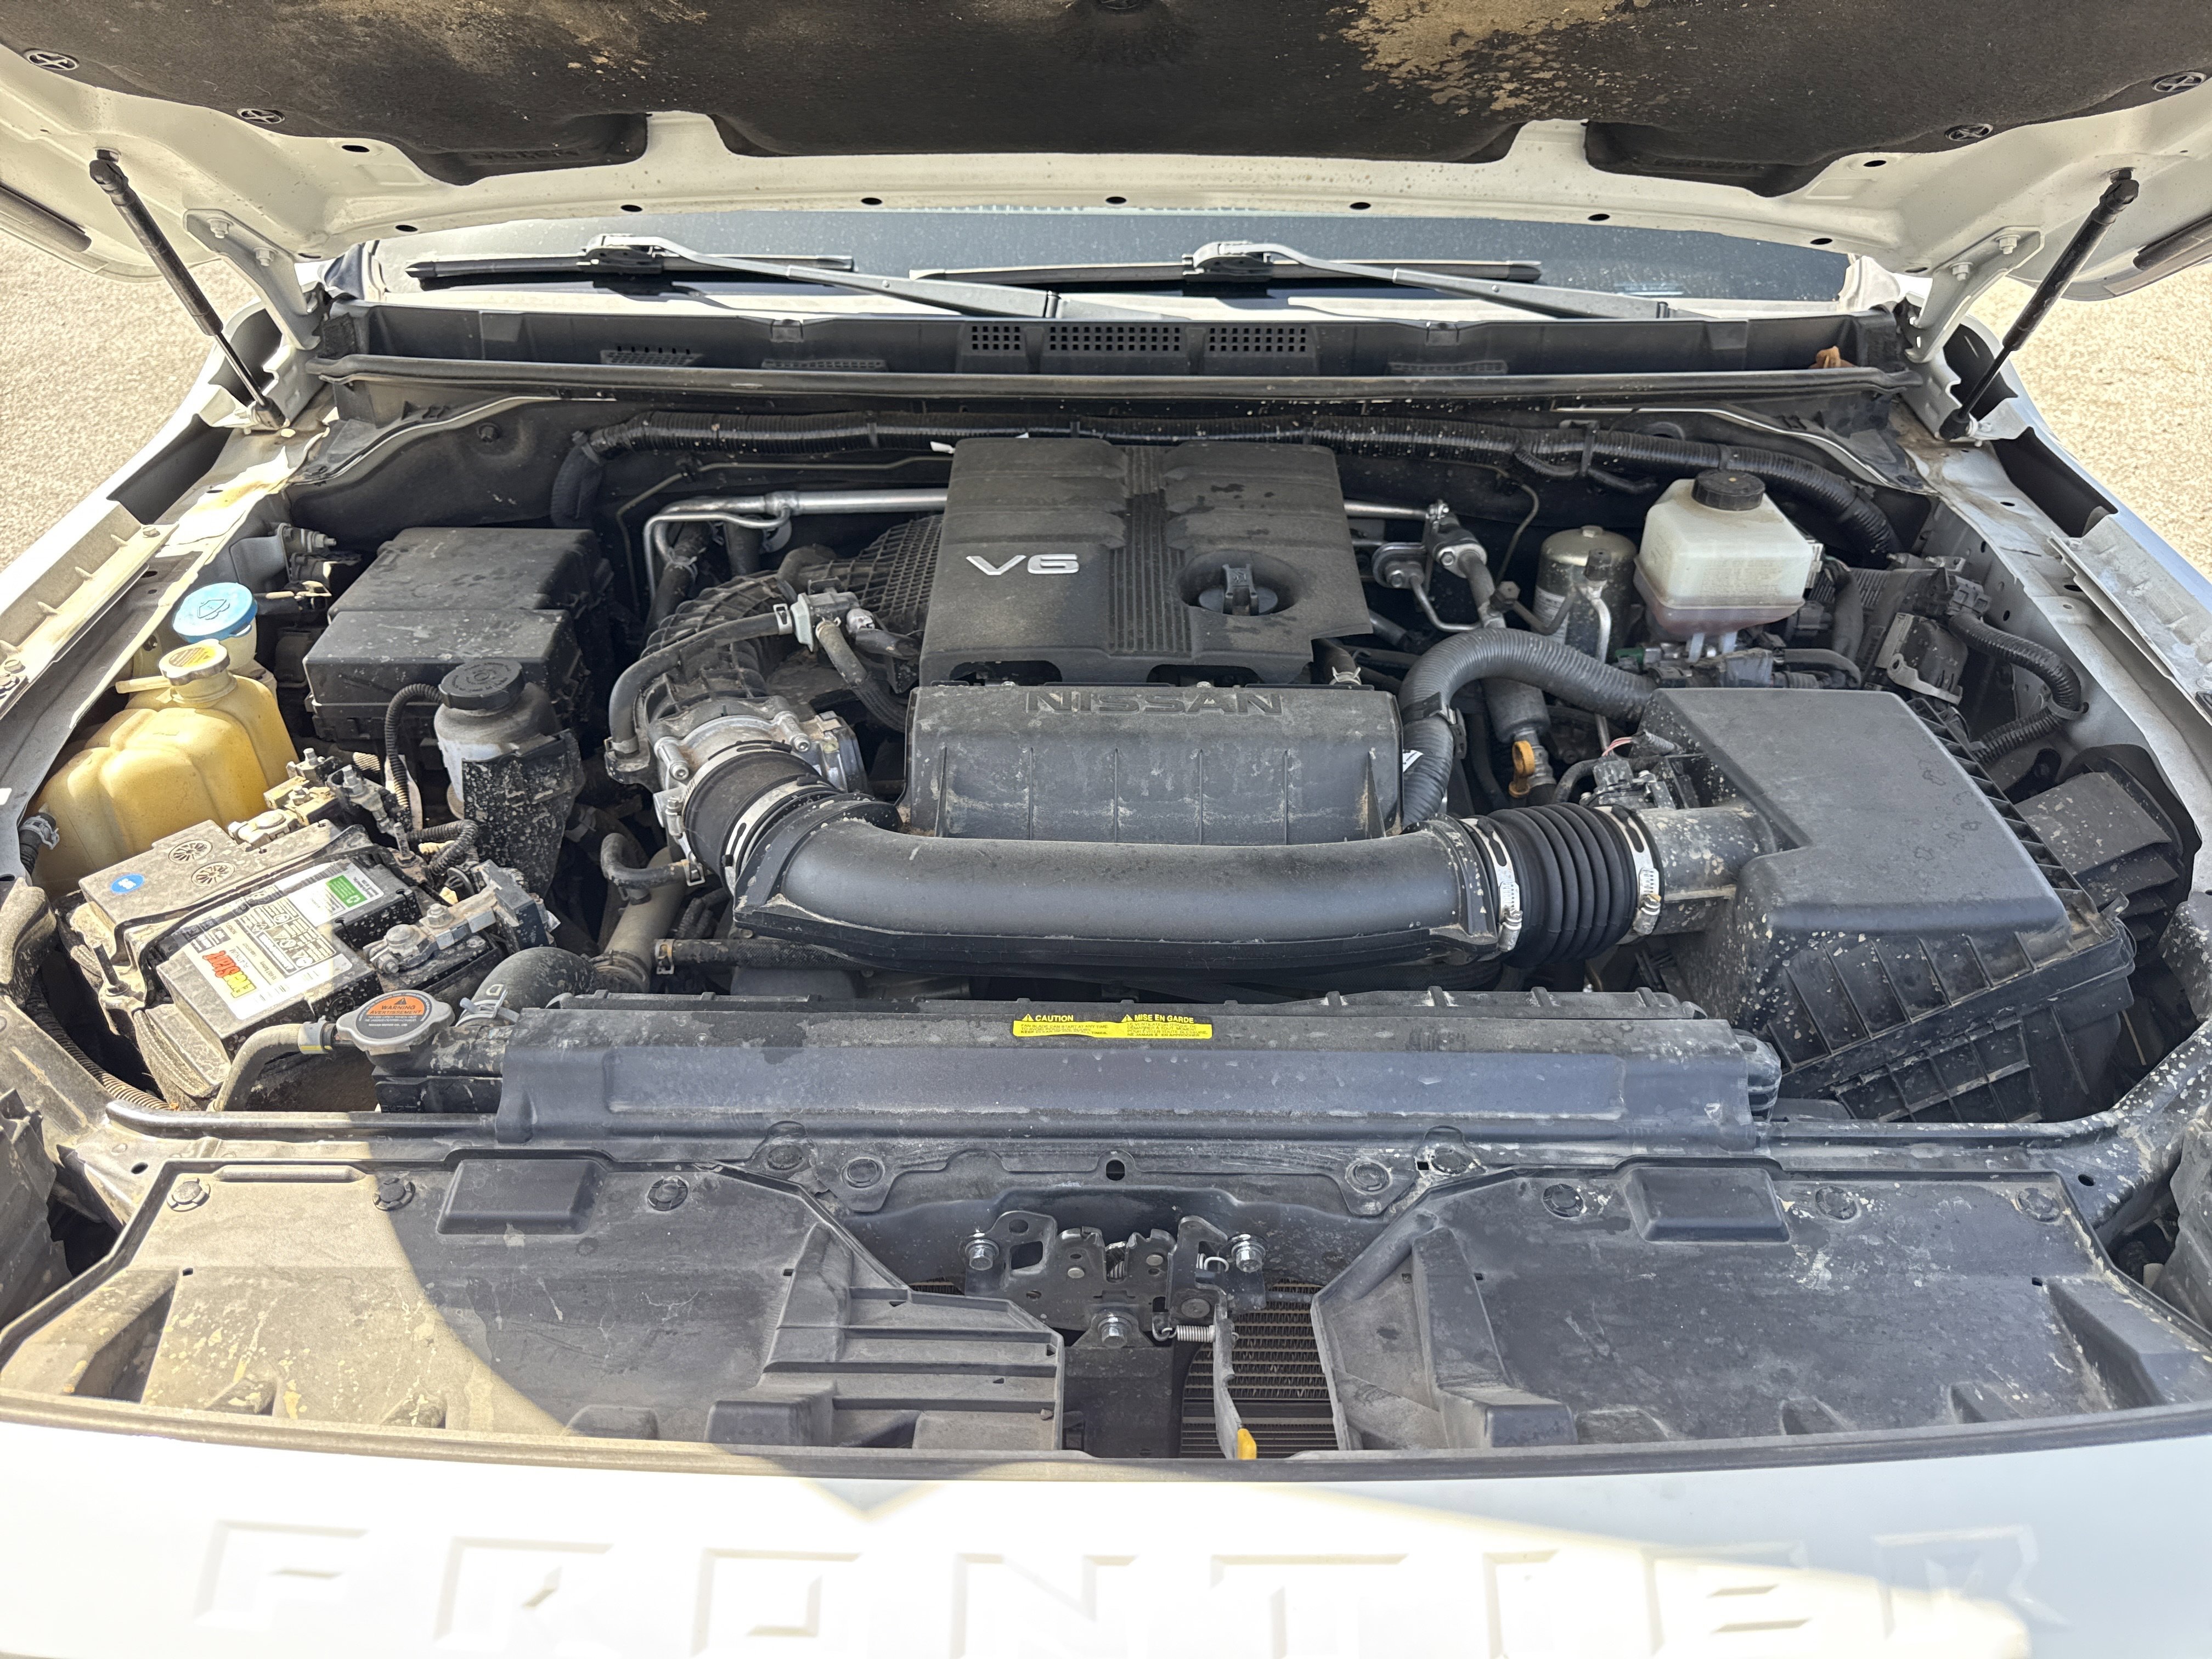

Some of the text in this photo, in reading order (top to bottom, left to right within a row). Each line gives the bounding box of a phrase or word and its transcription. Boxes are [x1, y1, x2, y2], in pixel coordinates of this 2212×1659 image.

[966, 549, 1079, 575] V6
[1026, 690, 1283, 714] NISSAN
[201, 949, 256, 998] EverStart
[1167, 1015, 1194, 1023] GARDE
